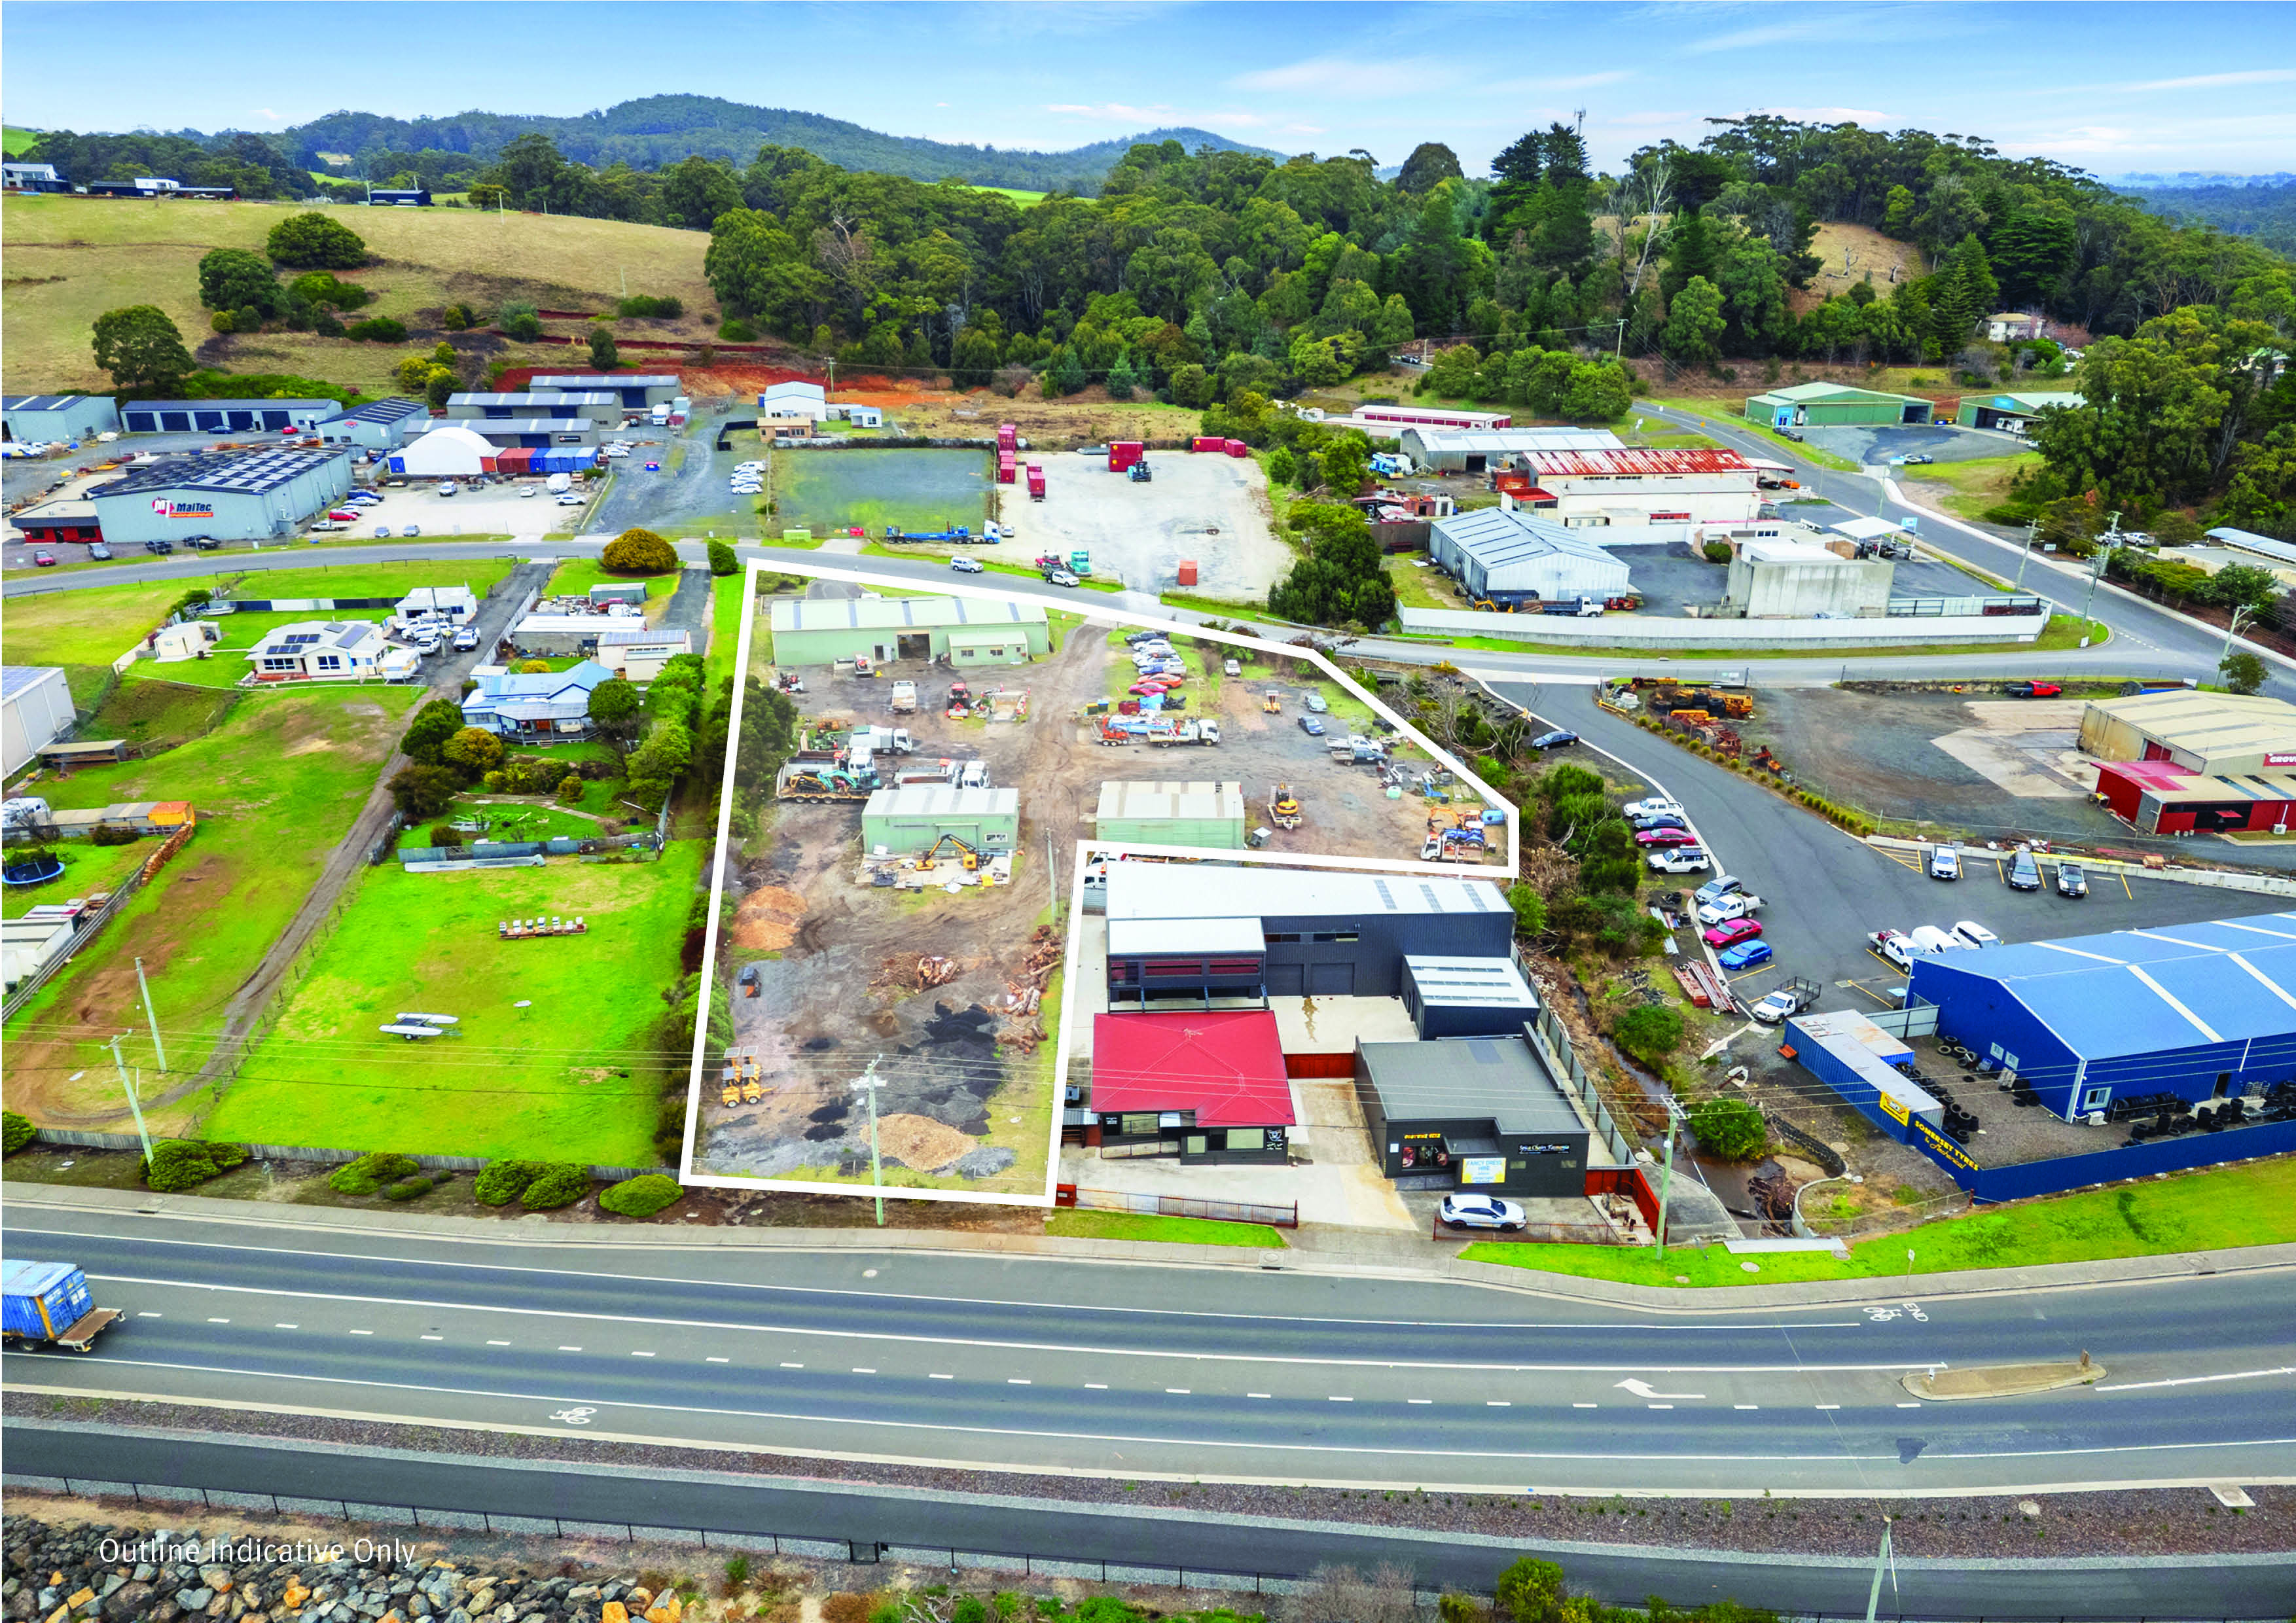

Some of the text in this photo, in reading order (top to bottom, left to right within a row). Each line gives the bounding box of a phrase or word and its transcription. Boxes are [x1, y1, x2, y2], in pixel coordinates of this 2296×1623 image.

[177, 503, 211, 512] MalTec
[1914, 1120, 1979, 1171] SOMERSET TYRES
[1929, 1143, 1966, 1169] Mechanical
[1902, 1303, 1929, 1322] END
